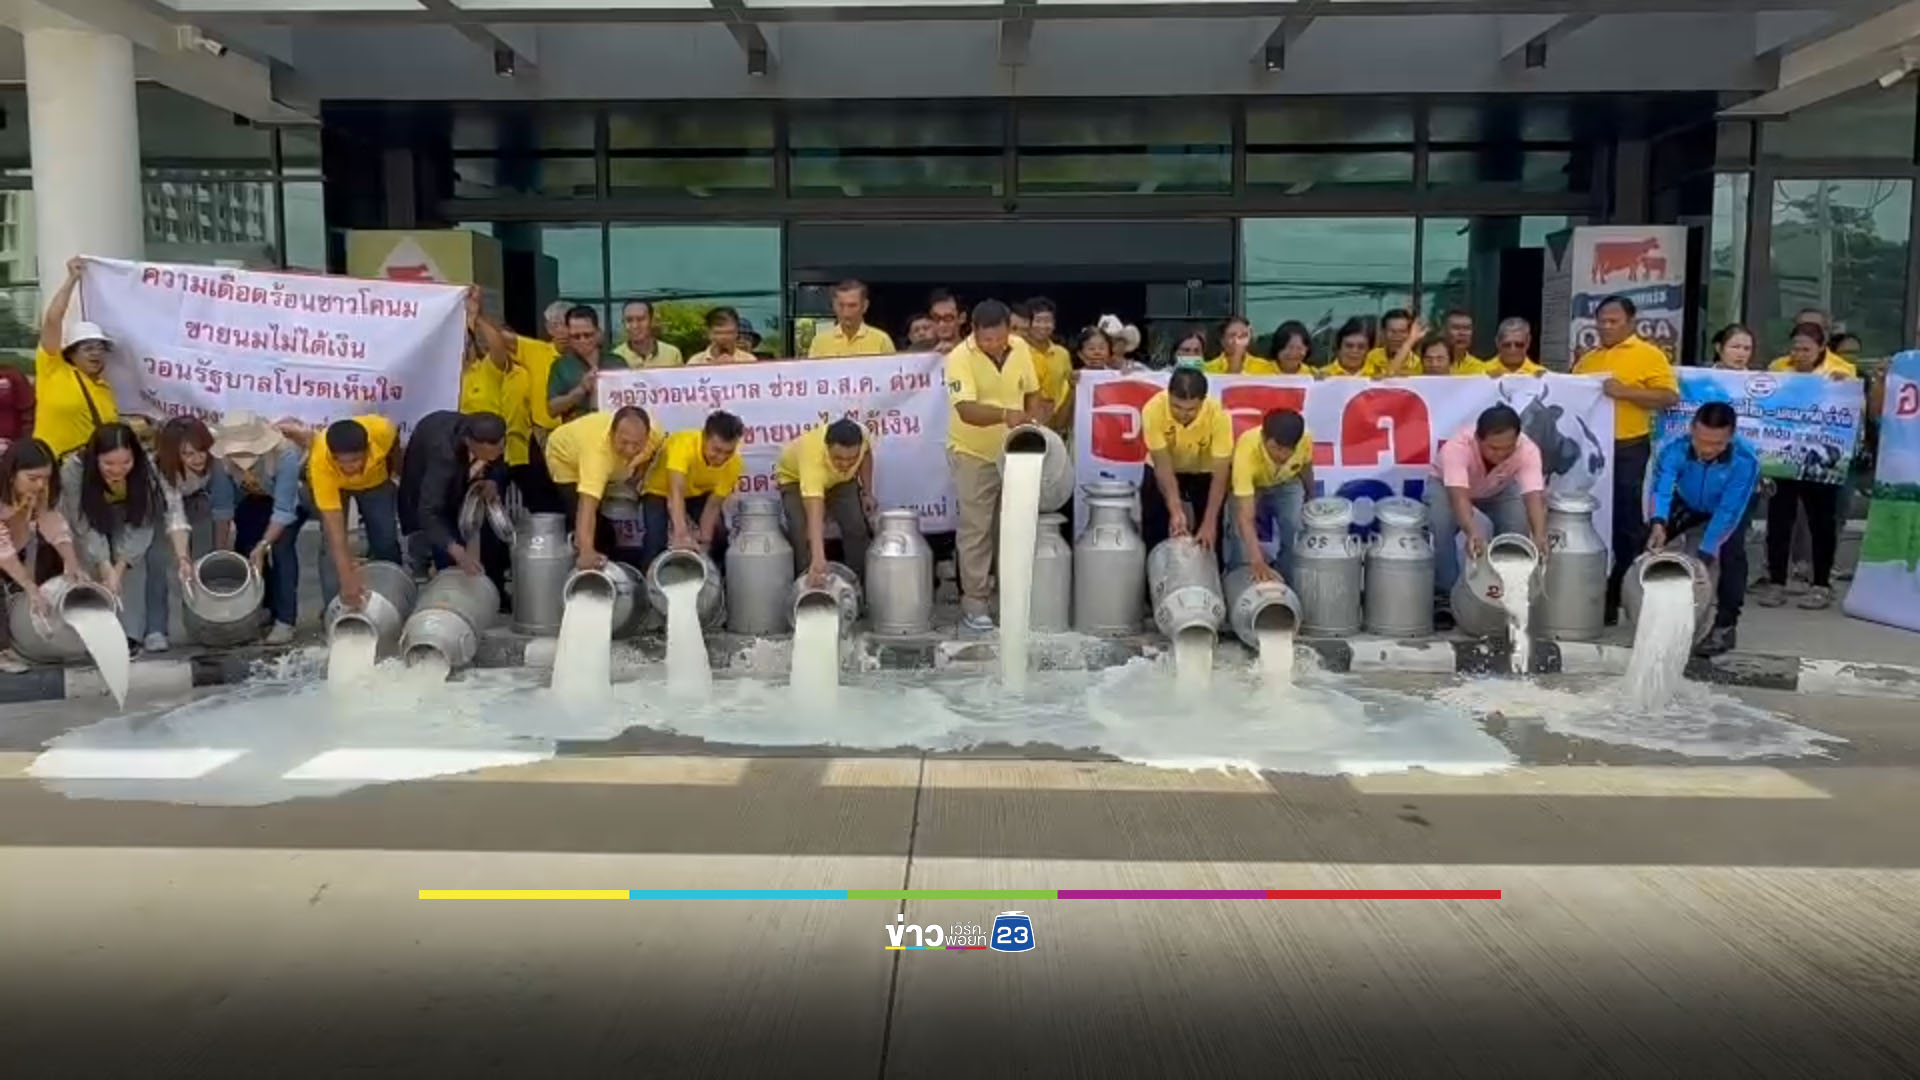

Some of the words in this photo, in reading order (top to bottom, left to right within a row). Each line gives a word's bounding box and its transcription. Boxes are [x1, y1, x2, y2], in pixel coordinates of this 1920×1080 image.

[185, 320, 366, 359] ขายนมไม่ได้เงิน
[143, 356, 404, 402] วอนรัฐบาลโปรดเห็นใจ
[608, 377, 761, 408] ขอวิงวอนรัฐบาล
[769, 372, 808, 397] ช่วย
[816, 375, 881, 396] อ.ส.ค.
[889, 366, 931, 392] ด่วน
